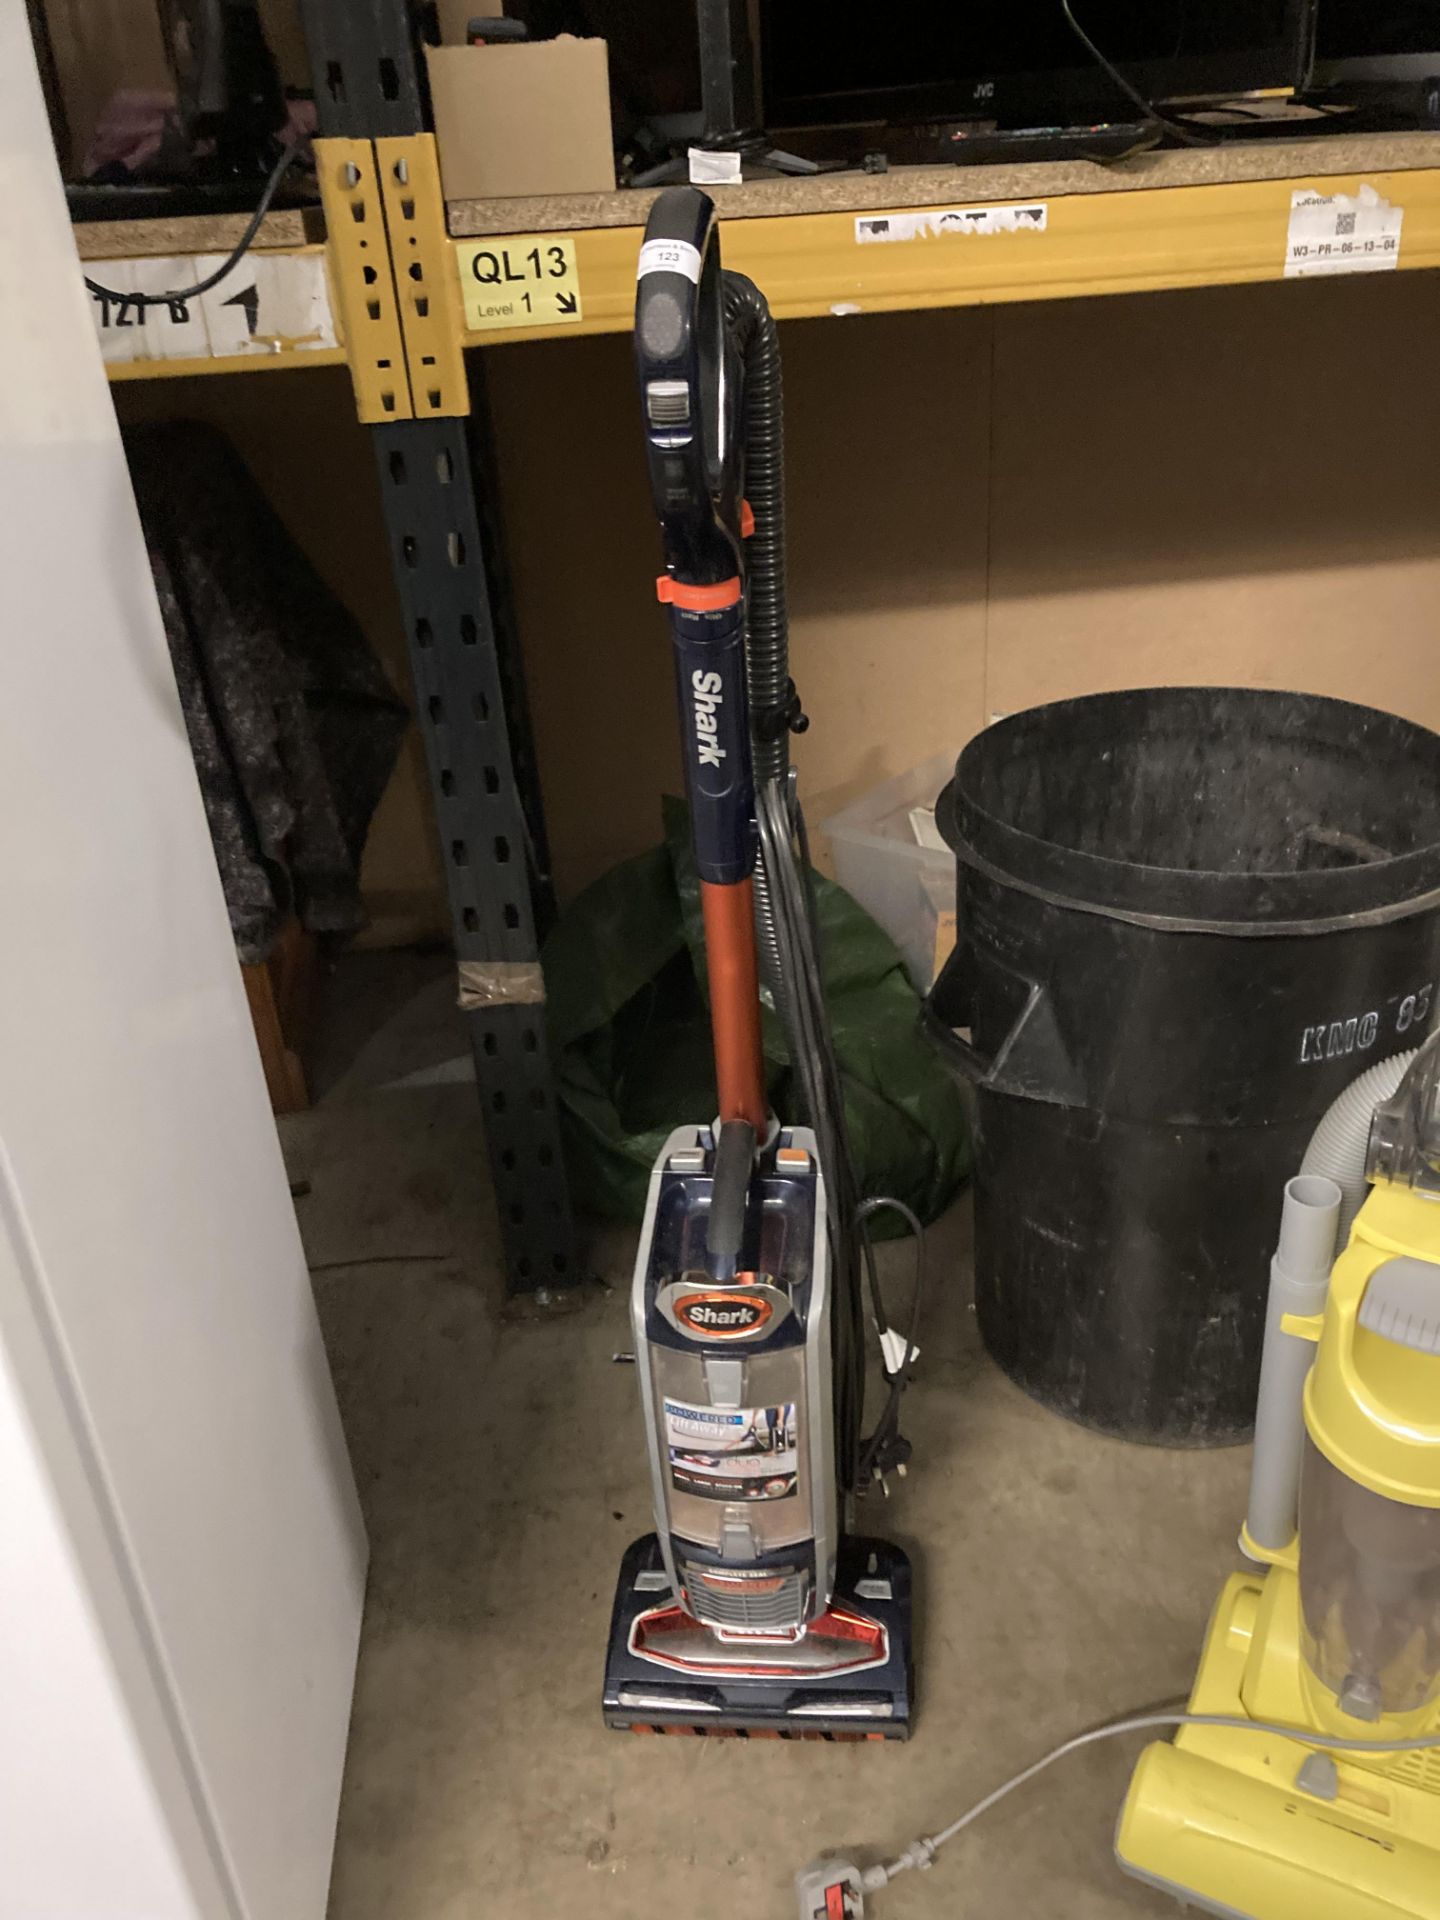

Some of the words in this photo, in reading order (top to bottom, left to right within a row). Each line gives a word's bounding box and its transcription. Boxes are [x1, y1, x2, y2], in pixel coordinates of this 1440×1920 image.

[973, 82, 995, 99] JVC
[472, 246, 568, 285] QL13
[658, 251, 680, 262] 123
[477, 302, 514, 318] Level
[520, 291, 532, 313] 1
[692, 669, 727, 769] Shark
[1300, 1011, 1379, 1062] KMC
[689, 1306, 754, 1326] Shark
